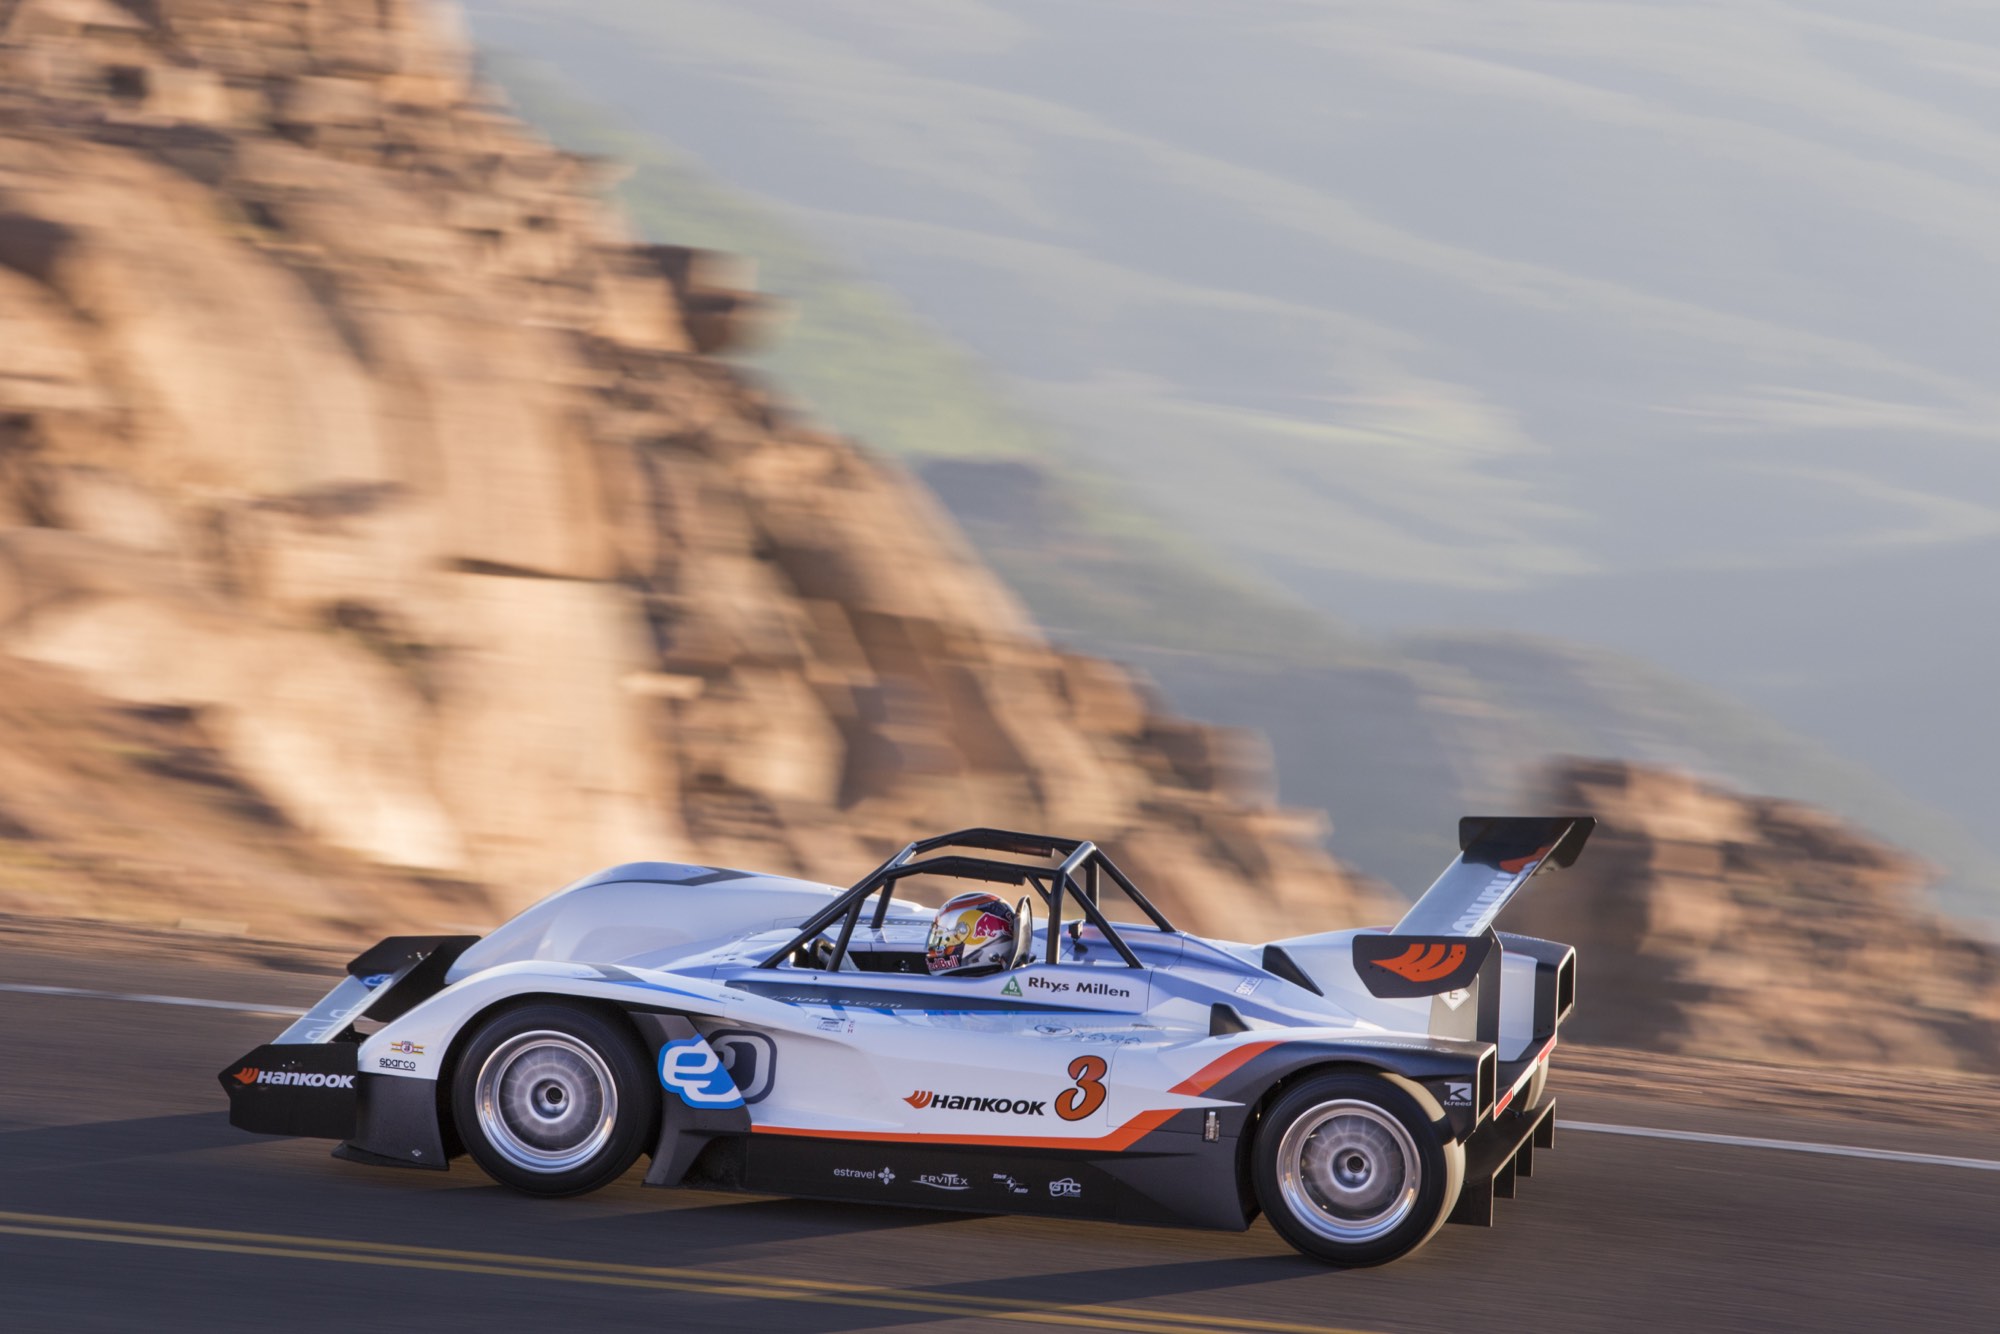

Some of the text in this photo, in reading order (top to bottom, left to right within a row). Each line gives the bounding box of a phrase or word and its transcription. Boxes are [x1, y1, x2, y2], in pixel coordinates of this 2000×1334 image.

[939, 955, 959, 969] Bull
[1028, 977, 1130, 998] Rhys Millen
[379, 1057, 417, 1070] sparco
[1055, 1055, 1107, 1122] 3
[833, 1168, 876, 1180] estravel
[920, 1173, 969, 1187] ERVITEX
